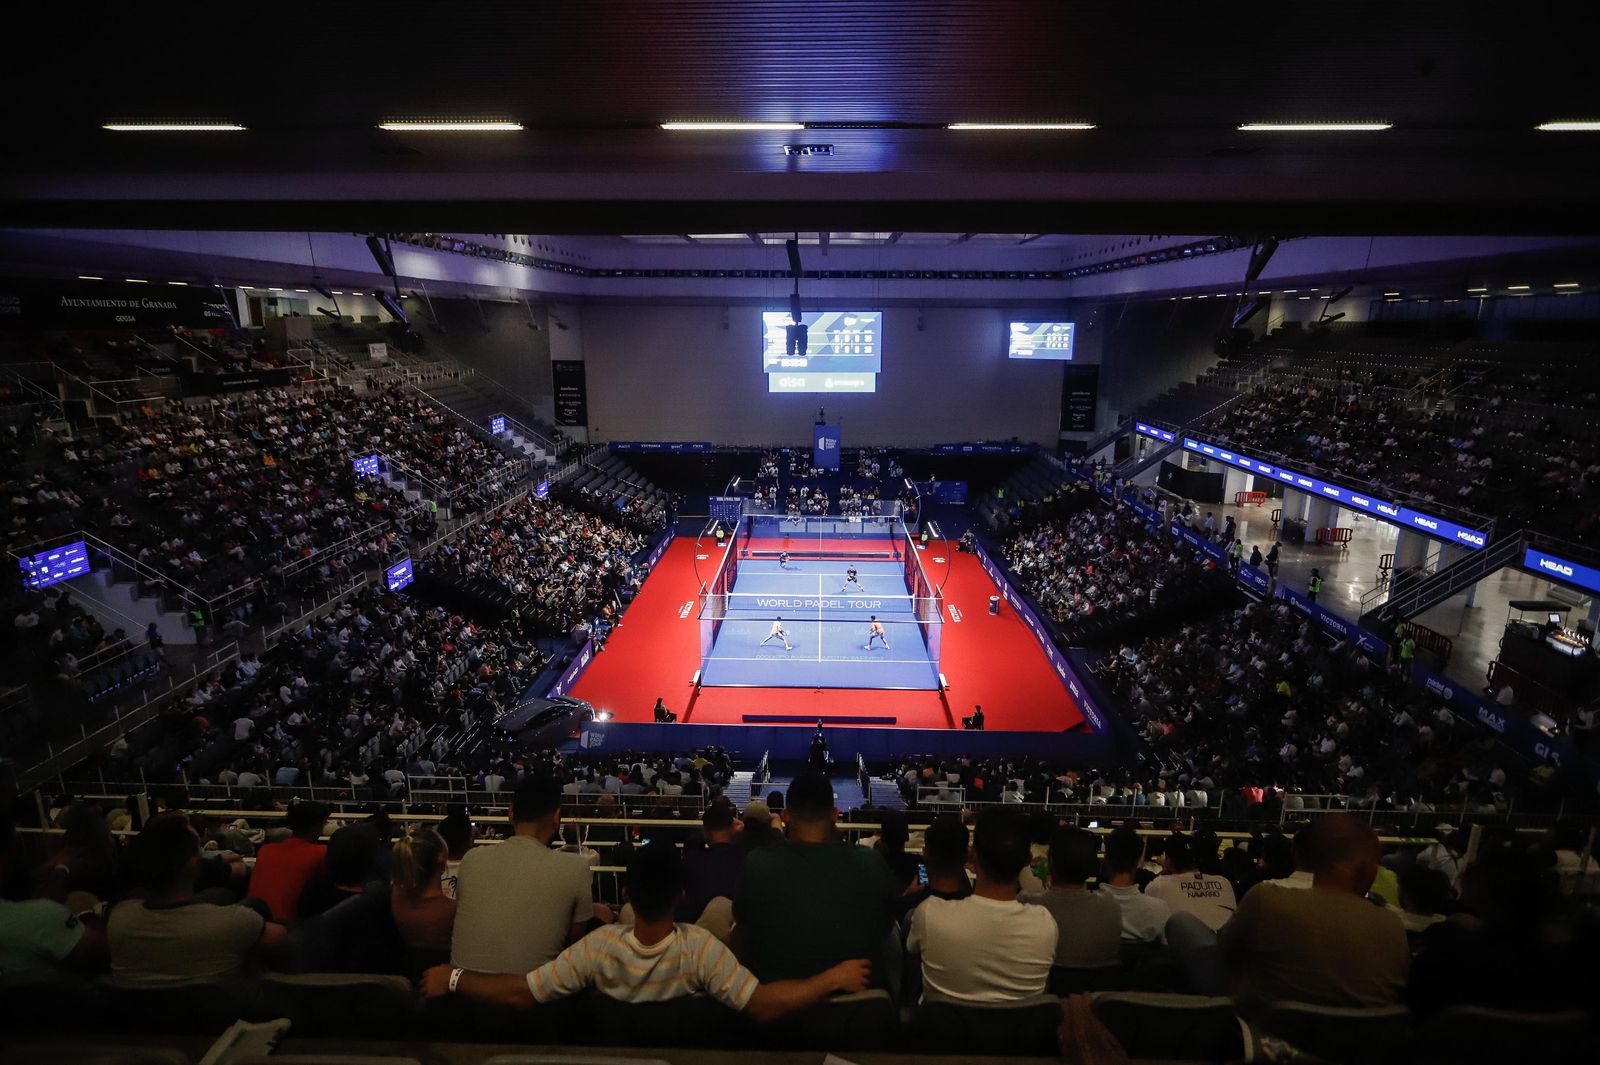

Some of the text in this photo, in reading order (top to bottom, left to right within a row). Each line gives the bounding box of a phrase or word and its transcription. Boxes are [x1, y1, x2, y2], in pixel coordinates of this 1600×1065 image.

[779, 377, 805, 387] alsa
[1323, 486, 1340, 496] HEAD
[1351, 495, 1369, 506] HEAD
[1414, 516, 1438, 530] HEAD
[1457, 530, 1484, 545] HEAD
[1539, 558, 1574, 577] HEAD
[756, 599, 882, 609] WORLD PADEL TOUR
[1320, 613, 1347, 634] VICTORIA
[1478, 706, 1505, 727] MAX
